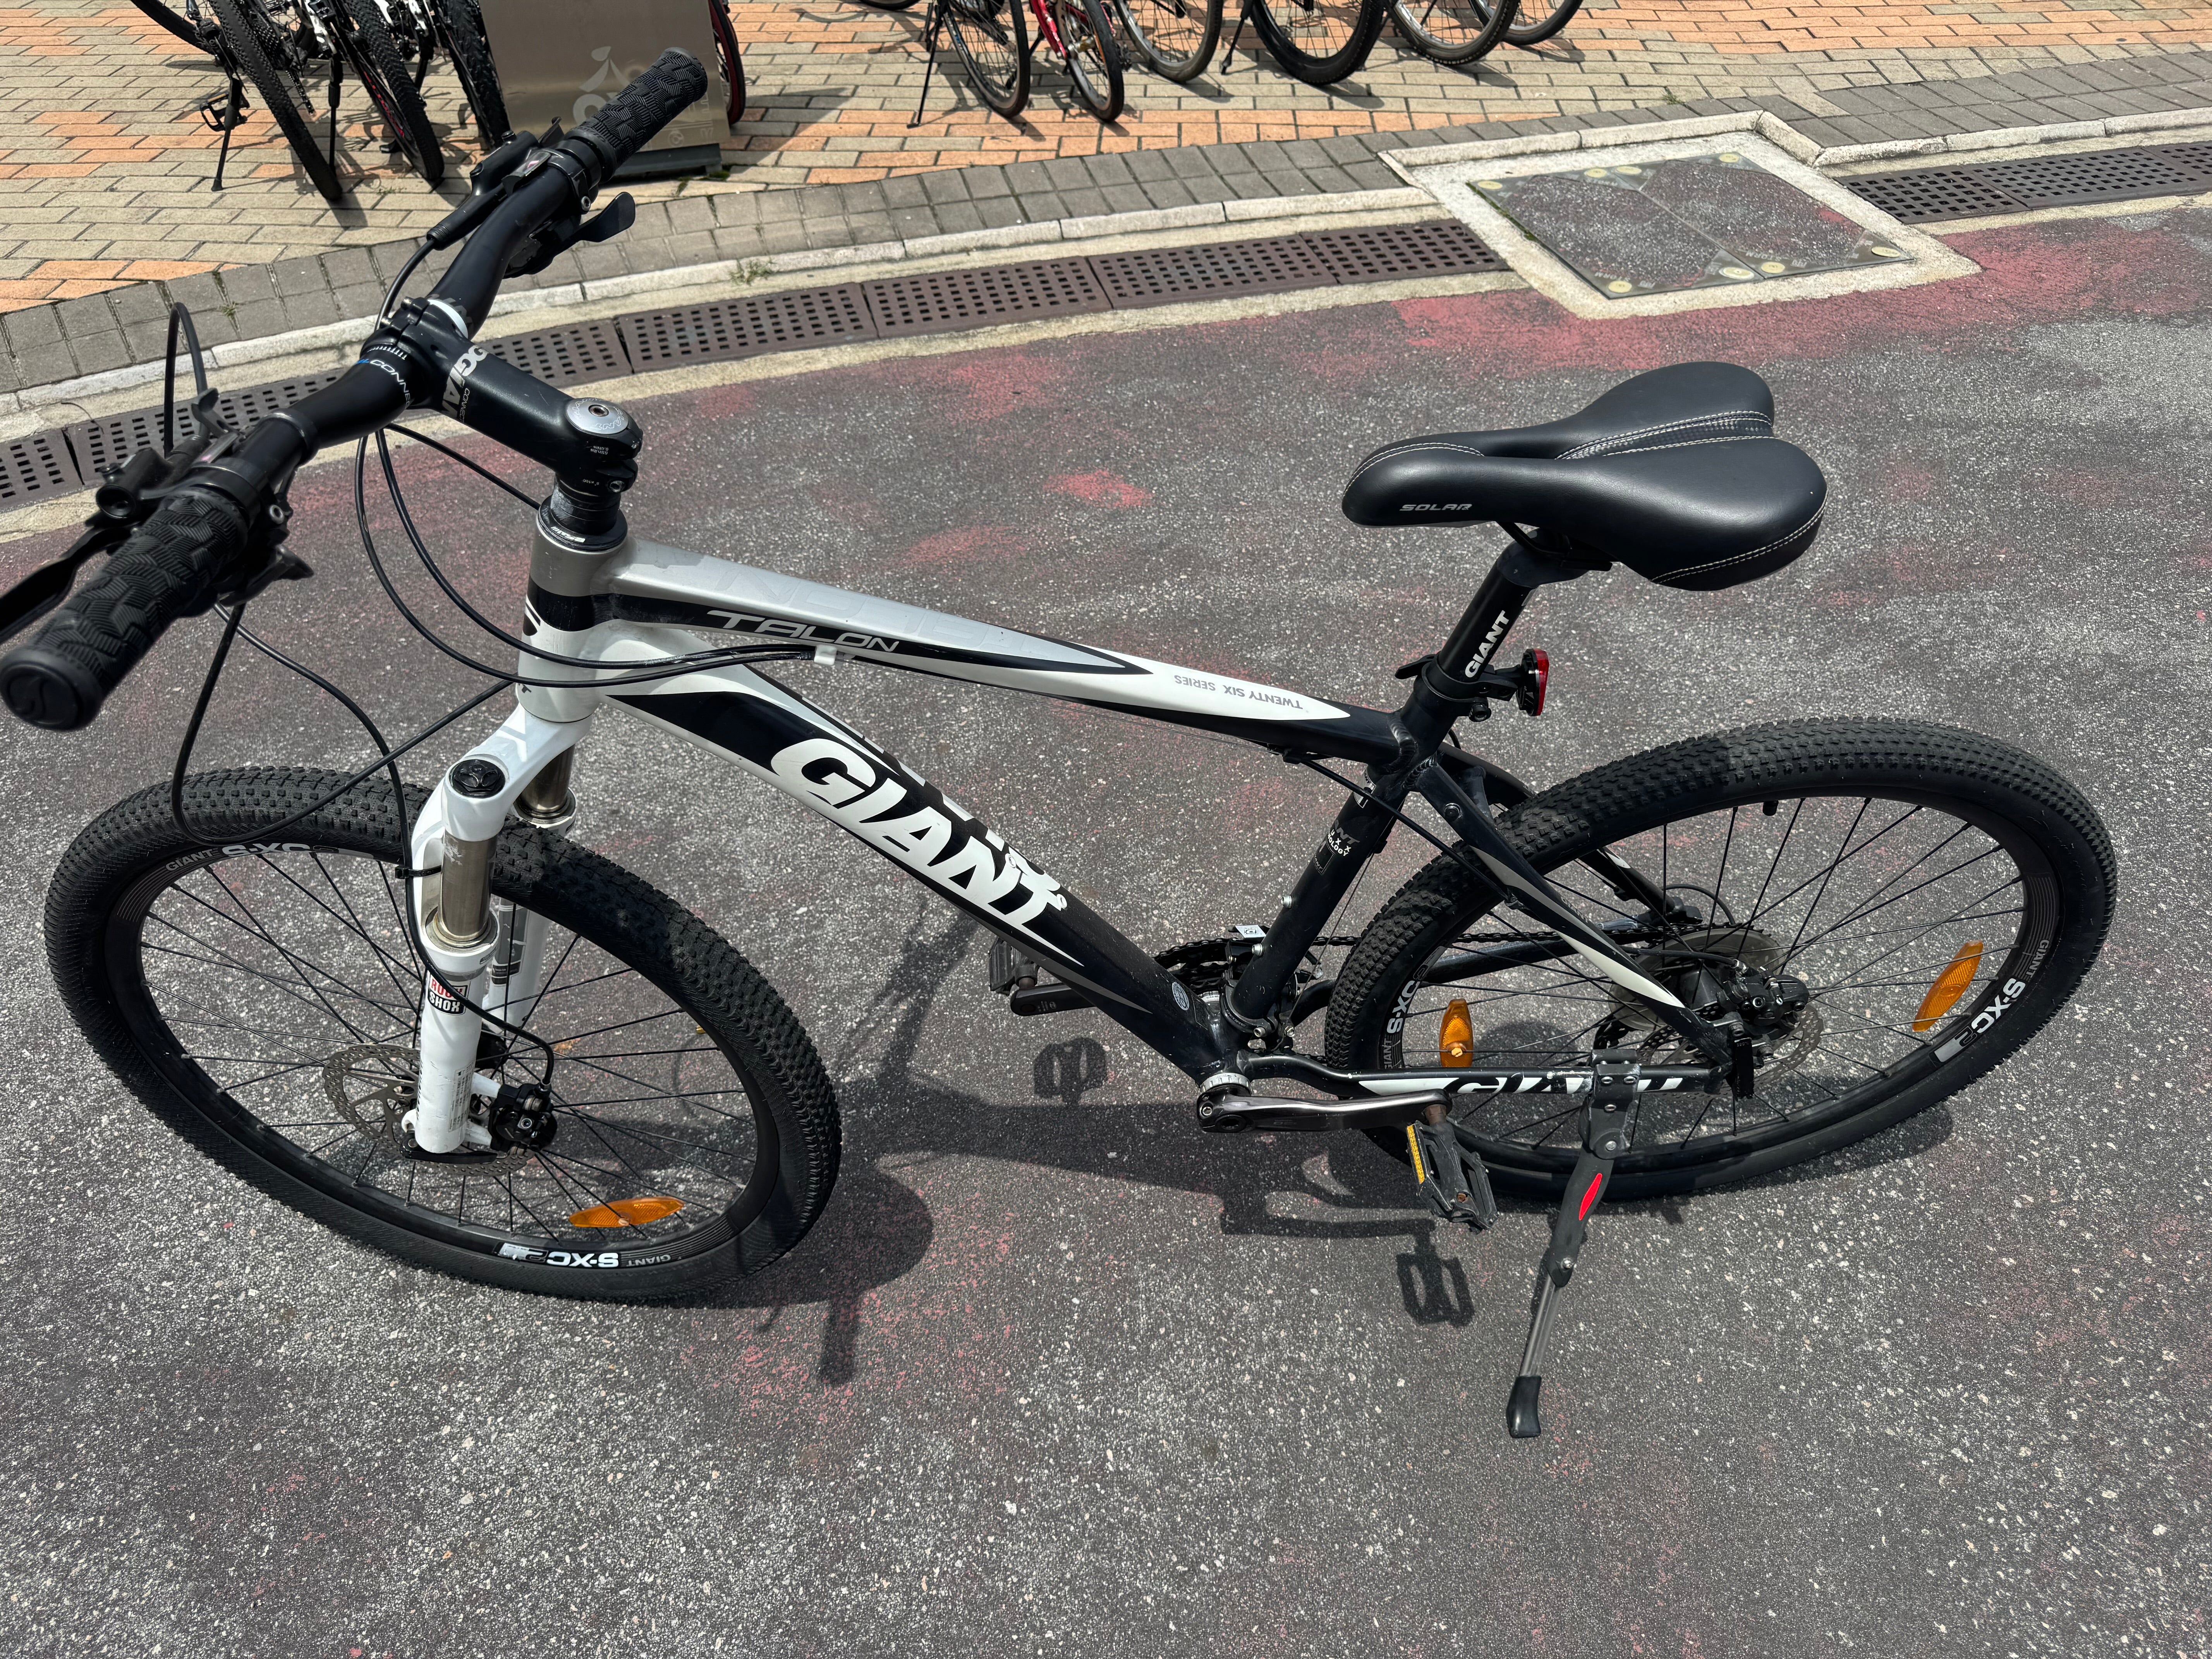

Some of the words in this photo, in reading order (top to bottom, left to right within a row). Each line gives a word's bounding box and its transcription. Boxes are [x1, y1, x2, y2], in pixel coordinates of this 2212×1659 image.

[706, 610, 899, 653] TALON
[1465, 610, 1509, 678] GIANT
[1174, 675, 1216, 691] SERIES
[1223, 685, 1245, 697] SIX
[1249, 691, 1304, 709] TWENTY
[771, 738, 1068, 933] GIANT
[165, 849, 213, 871] GIANT
[2026, 939, 2050, 978] GIANT
[429, 991, 460, 1012] SHOX
[626, 1254, 672, 1267] GIANT
